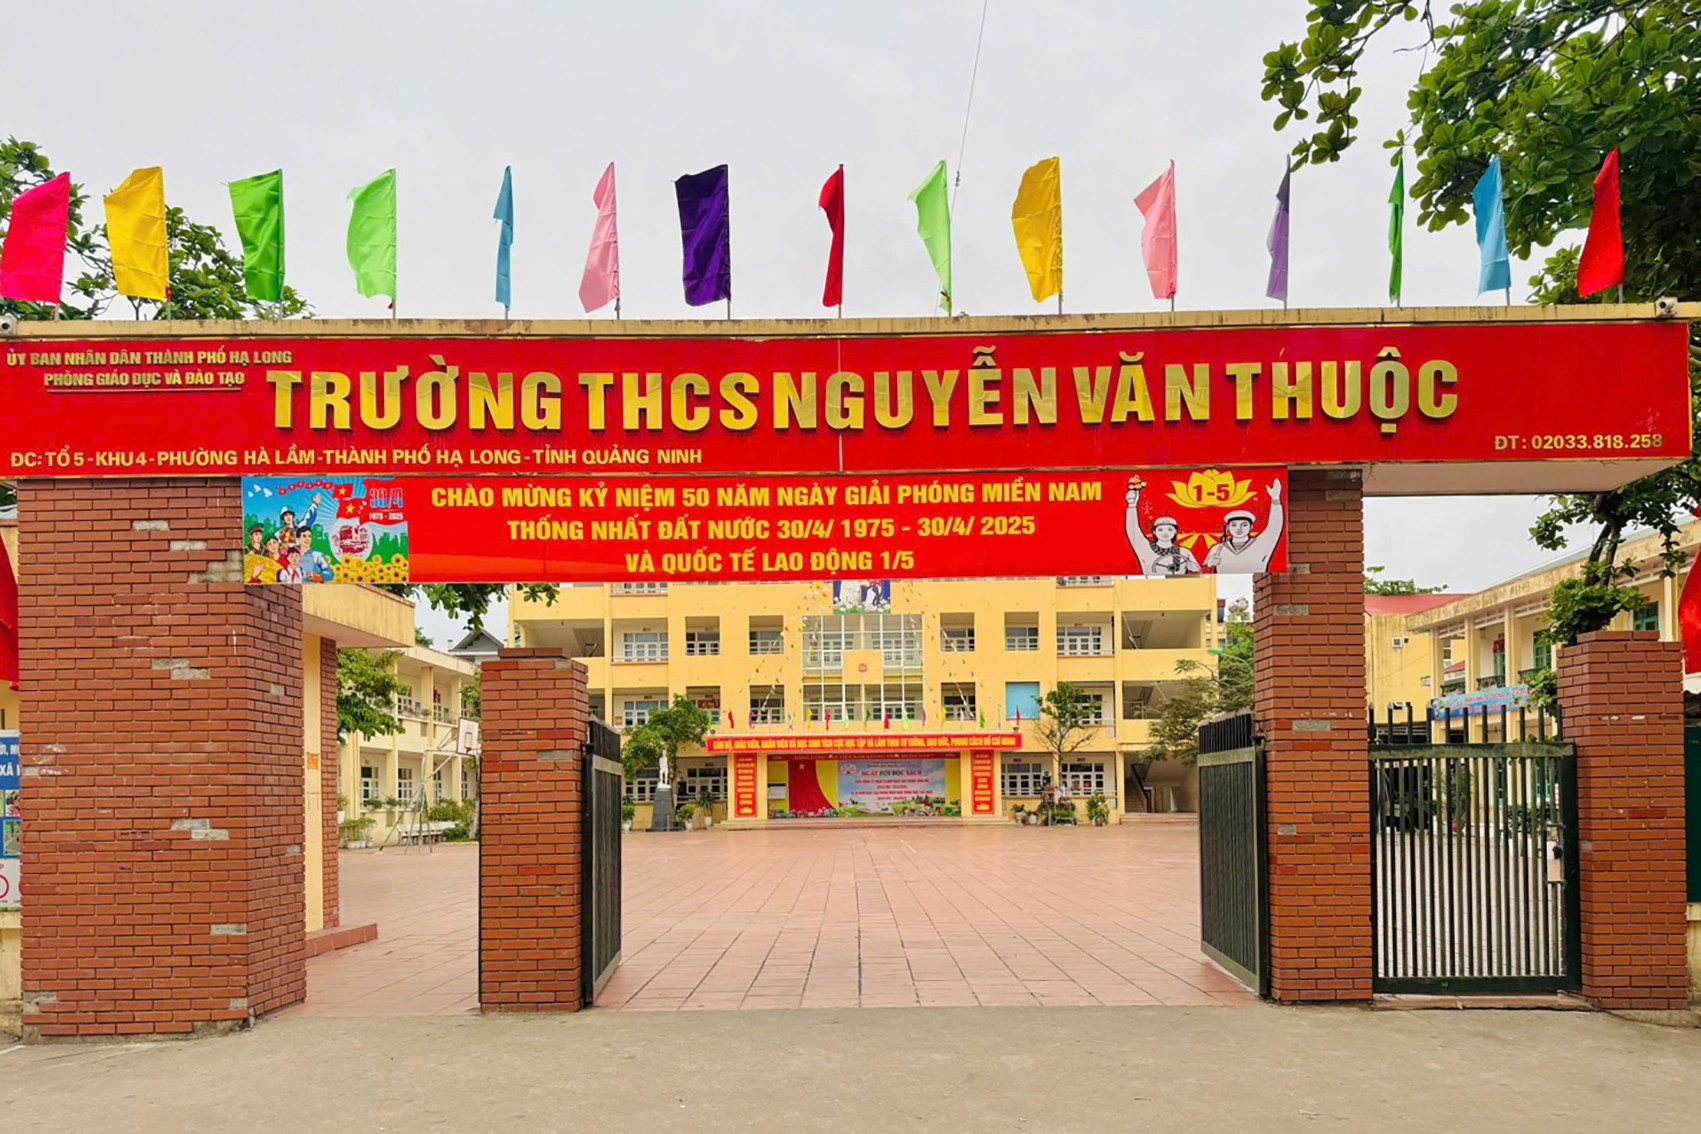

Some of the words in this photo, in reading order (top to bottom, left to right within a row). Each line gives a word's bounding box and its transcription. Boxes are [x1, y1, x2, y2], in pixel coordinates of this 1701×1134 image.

[7, 349, 26, 365] ỦY
[31, 353, 61, 365] BAN
[65, 350, 106, 365] NHÂN
[110, 350, 141, 364] DÂN
[145, 350, 194, 364] THÀNH
[198, 347, 226, 363] PHỐ
[230, 351, 249, 366] HẠ
[254, 351, 291, 363] LONG
[44, 371, 93, 386] PHÒNG
[96, 370, 129, 385] GIÁO
[133, 373, 161, 387] DỤC
[165, 370, 182, 384] VÀ
[185, 369, 214, 384] ĐÀO
[218, 372, 245, 386] TẠO
[266, 354, 562, 430] TRƯỜNG
[579, 373, 759, 431] THCS
[773, 346, 1057, 429] NGUYỄN
[1073, 352, 1209, 423] VĂN
[1226, 347, 1457, 432] THUỘC
[1532, 434, 1662, 449] 02033.818.258
[45, 446, 70, 466] TỔ
[96, 452, 133, 466] KHU
[158, 447, 237, 466] PHƯỜNG
[245, 447, 270, 464] HÀ
[276, 445, 314, 464] LẦM
[323, 446, 386, 464] THÀNH
[393, 444, 431, 464] PHỐ
[437, 450, 463, 467] HẠ
[470, 450, 520, 464] LONG
[533, 444, 576, 463] TỈNH
[582, 444, 649, 464] QUẢNG
[658, 449, 701, 463] NINH
[432, 484, 494, 507] CHÀO
[502, 484, 571, 507] MỪNG
[580, 482, 608, 507] KỶ
[616, 484, 674, 511] NIỆM
[683, 488, 709, 506] 50
[717, 484, 769, 506] NĂM
[777, 483, 837, 506] NGÀY
[845, 479, 889, 505] GIẢI
[898, 481, 974, 504] PHÓNG
[982, 477, 1040, 502] MIỀN
[1049, 482, 1101, 501] NAM
[1192, 483, 1230, 502] 1-5
[507, 514, 583, 540] THỐNG
[592, 514, 651, 540] NHẤT
[658, 514, 700, 539] ĐẤT
[708, 516, 769, 539] NƯỚC
[778, 519, 834, 538] 30/4/
[842, 519, 894, 537] 1975
[918, 516, 974, 536] 30/4/
[981, 516, 1035, 535] 2025
[626, 550, 655, 572] VÀ
[662, 547, 722, 574] QUỐC
[730, 547, 755, 571] TẾ
[763, 552, 803, 571] LAO
[810, 548, 872, 574] ĐỘNG
[881, 551, 914, 569] 1/5
